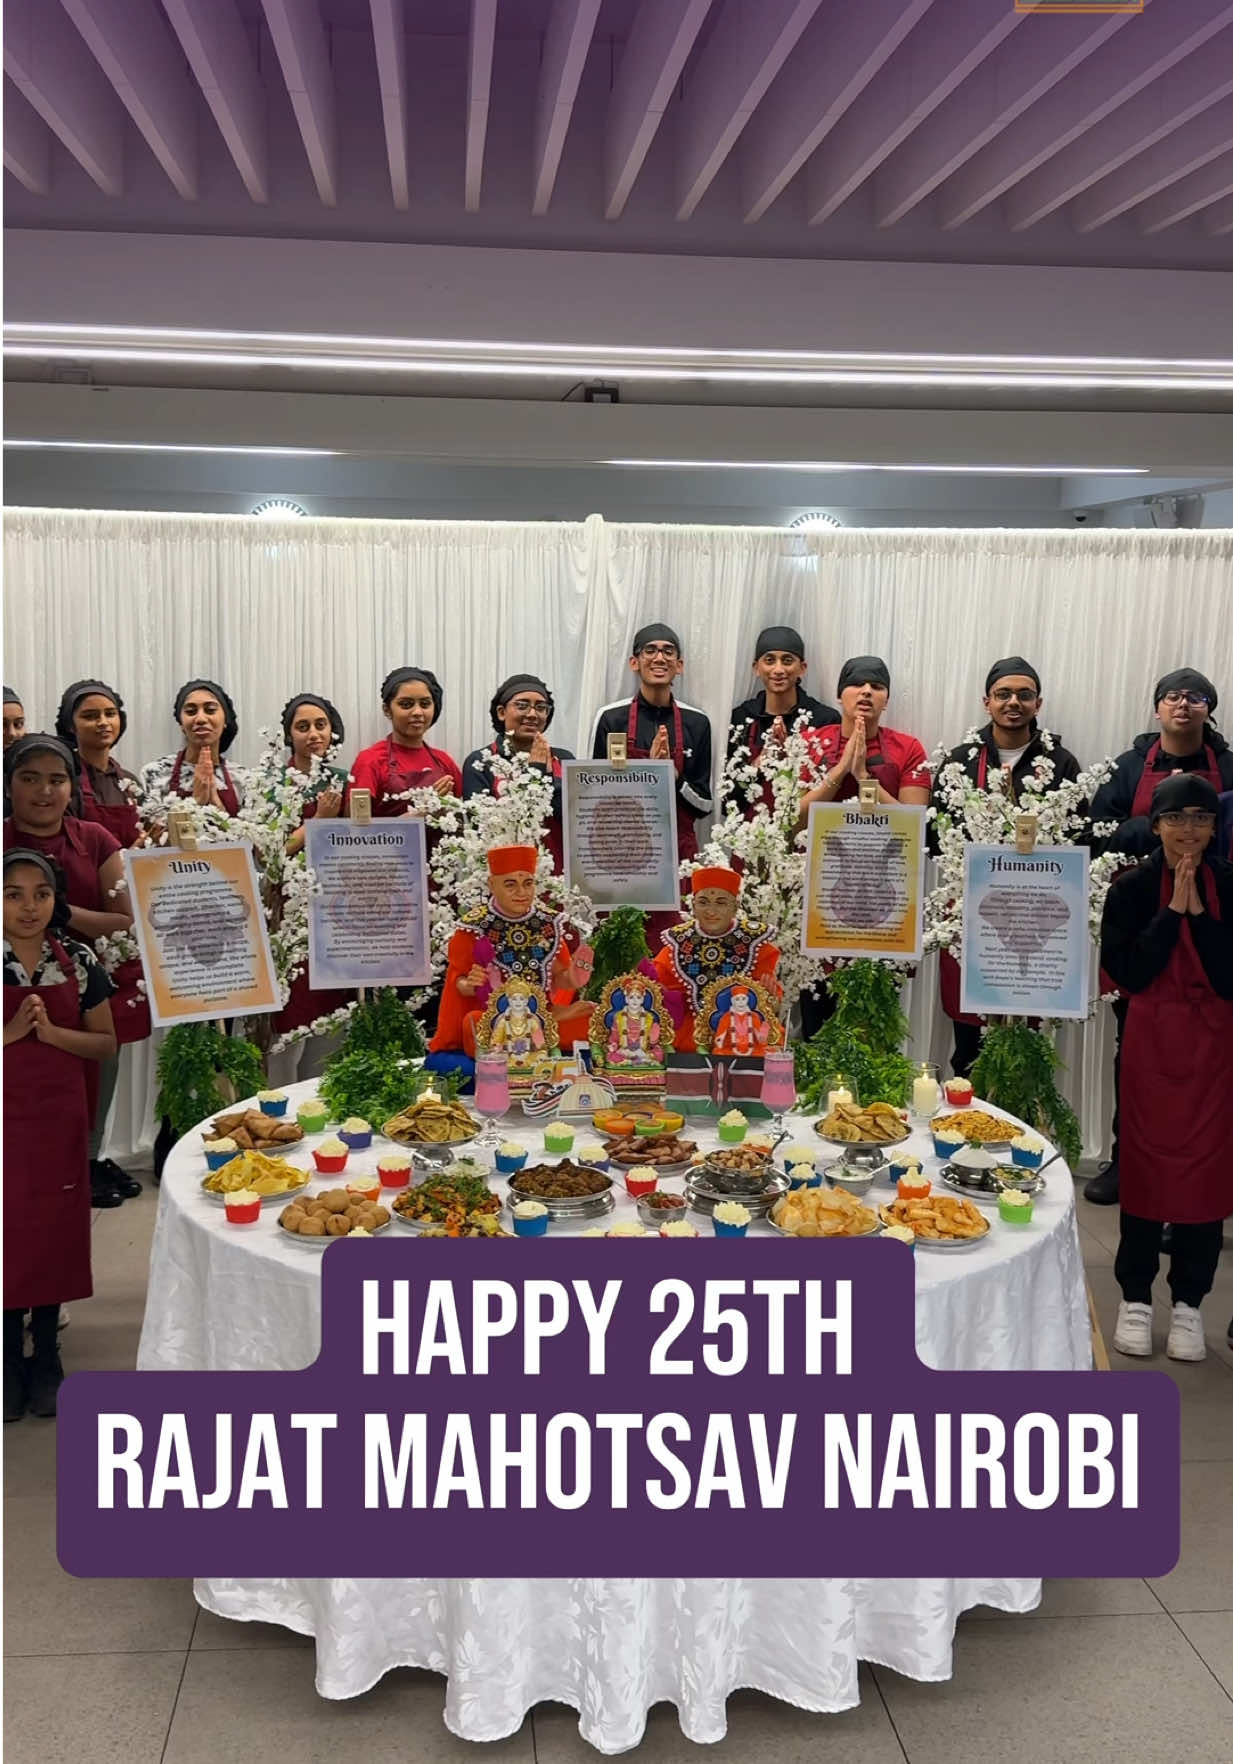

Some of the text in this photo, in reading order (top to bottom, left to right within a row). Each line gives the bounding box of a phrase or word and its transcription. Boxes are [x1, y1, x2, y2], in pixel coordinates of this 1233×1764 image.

[576, 771, 659, 786] Responsibilty
[842, 813, 889, 828] Bhakti
[328, 833, 404, 847] Innovation
[168, 860, 211, 875] Unity
[987, 855, 1064, 876] Humanity
